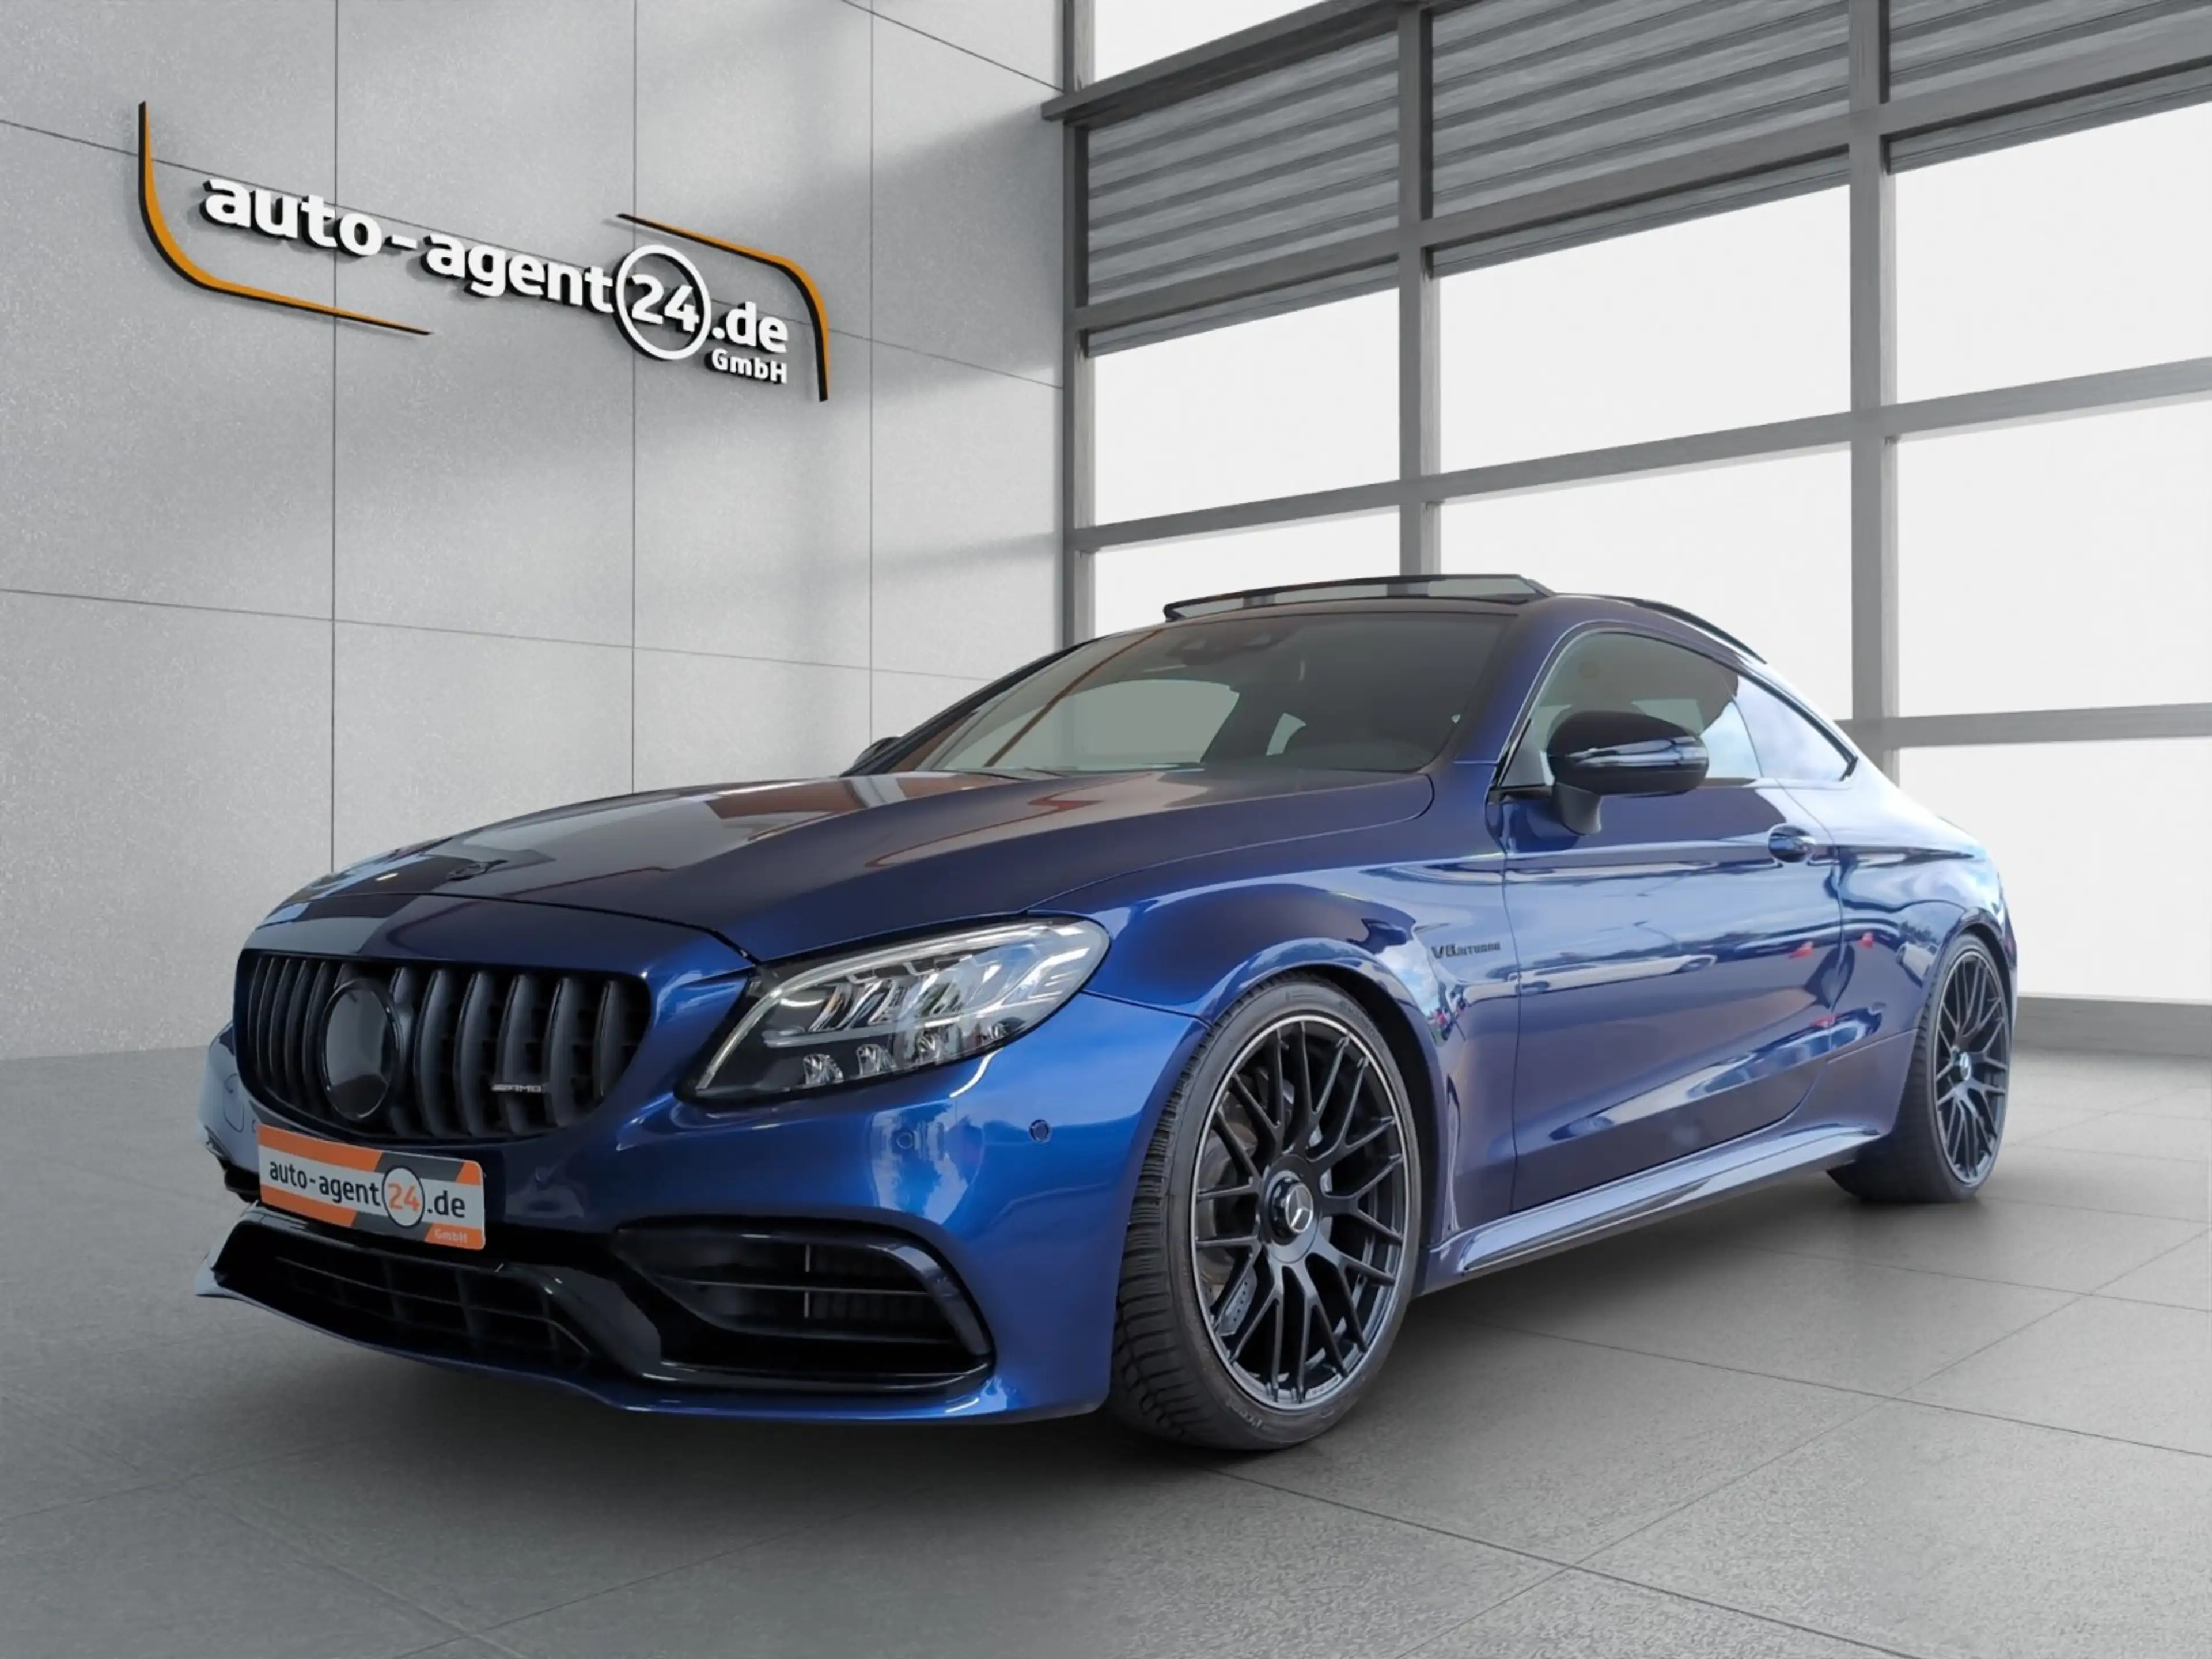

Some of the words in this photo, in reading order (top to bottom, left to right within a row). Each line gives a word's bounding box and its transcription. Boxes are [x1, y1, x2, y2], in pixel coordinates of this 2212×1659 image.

[203, 179, 788, 354] auto-agent24.de
[711, 348, 787, 384] GmbH
[269, 1160, 465, 1218] auto-agent24.de
[434, 1228, 468, 1244] GmbH
